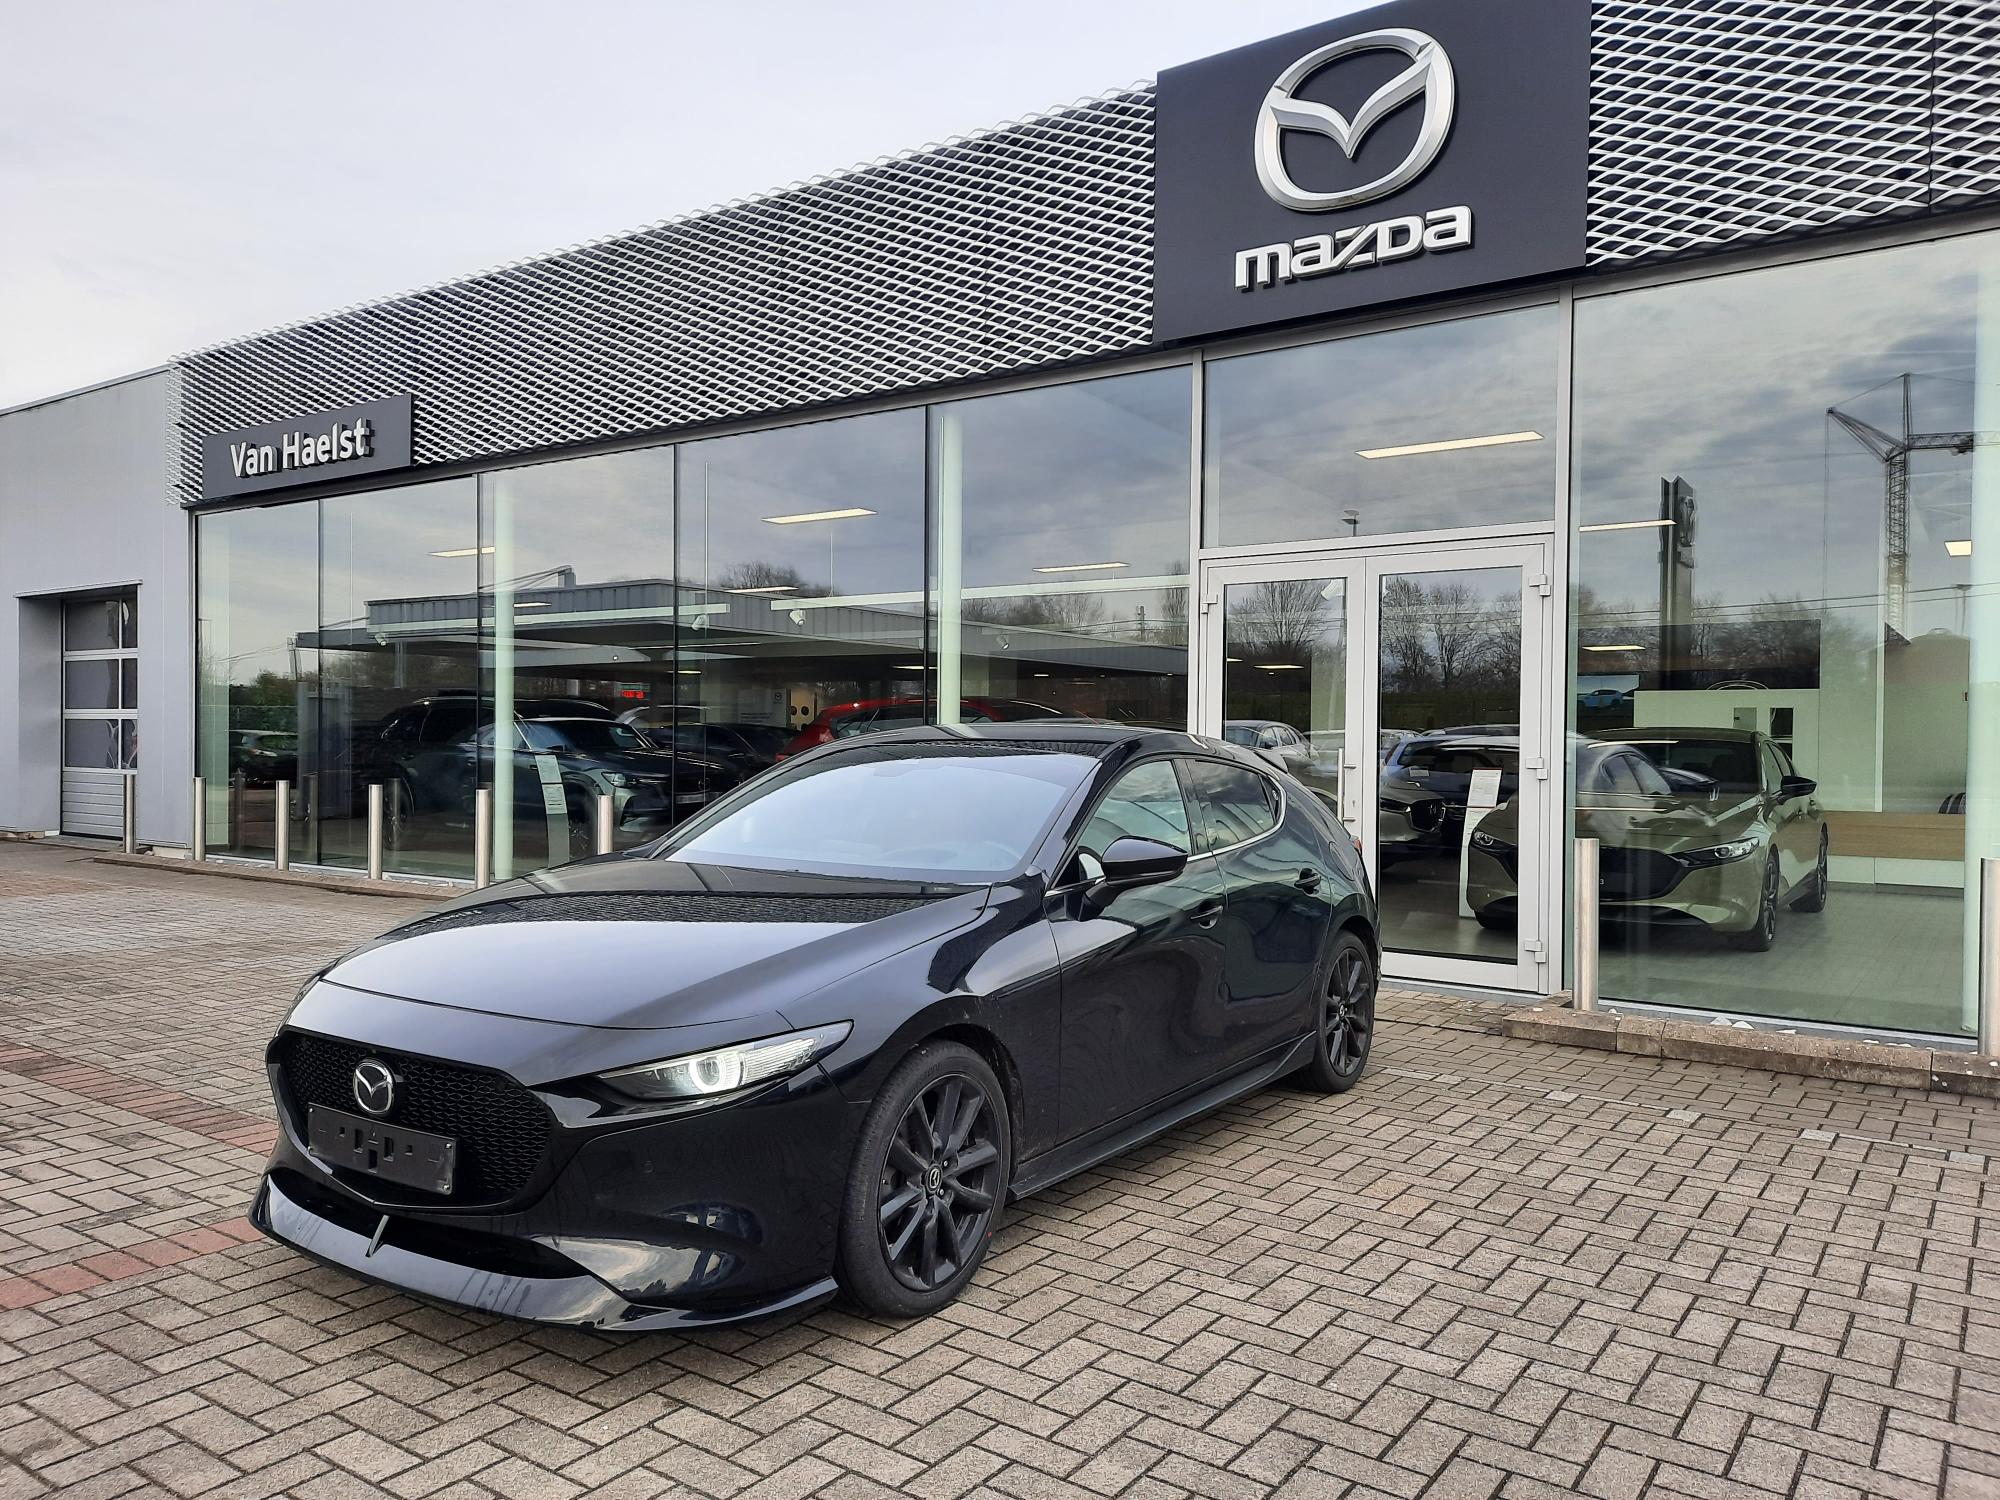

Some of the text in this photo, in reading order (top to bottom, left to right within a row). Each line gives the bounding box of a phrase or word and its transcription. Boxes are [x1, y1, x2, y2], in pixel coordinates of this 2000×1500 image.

[1234, 205, 1472, 288] mazda
[230, 417, 370, 477] Van Haelst
